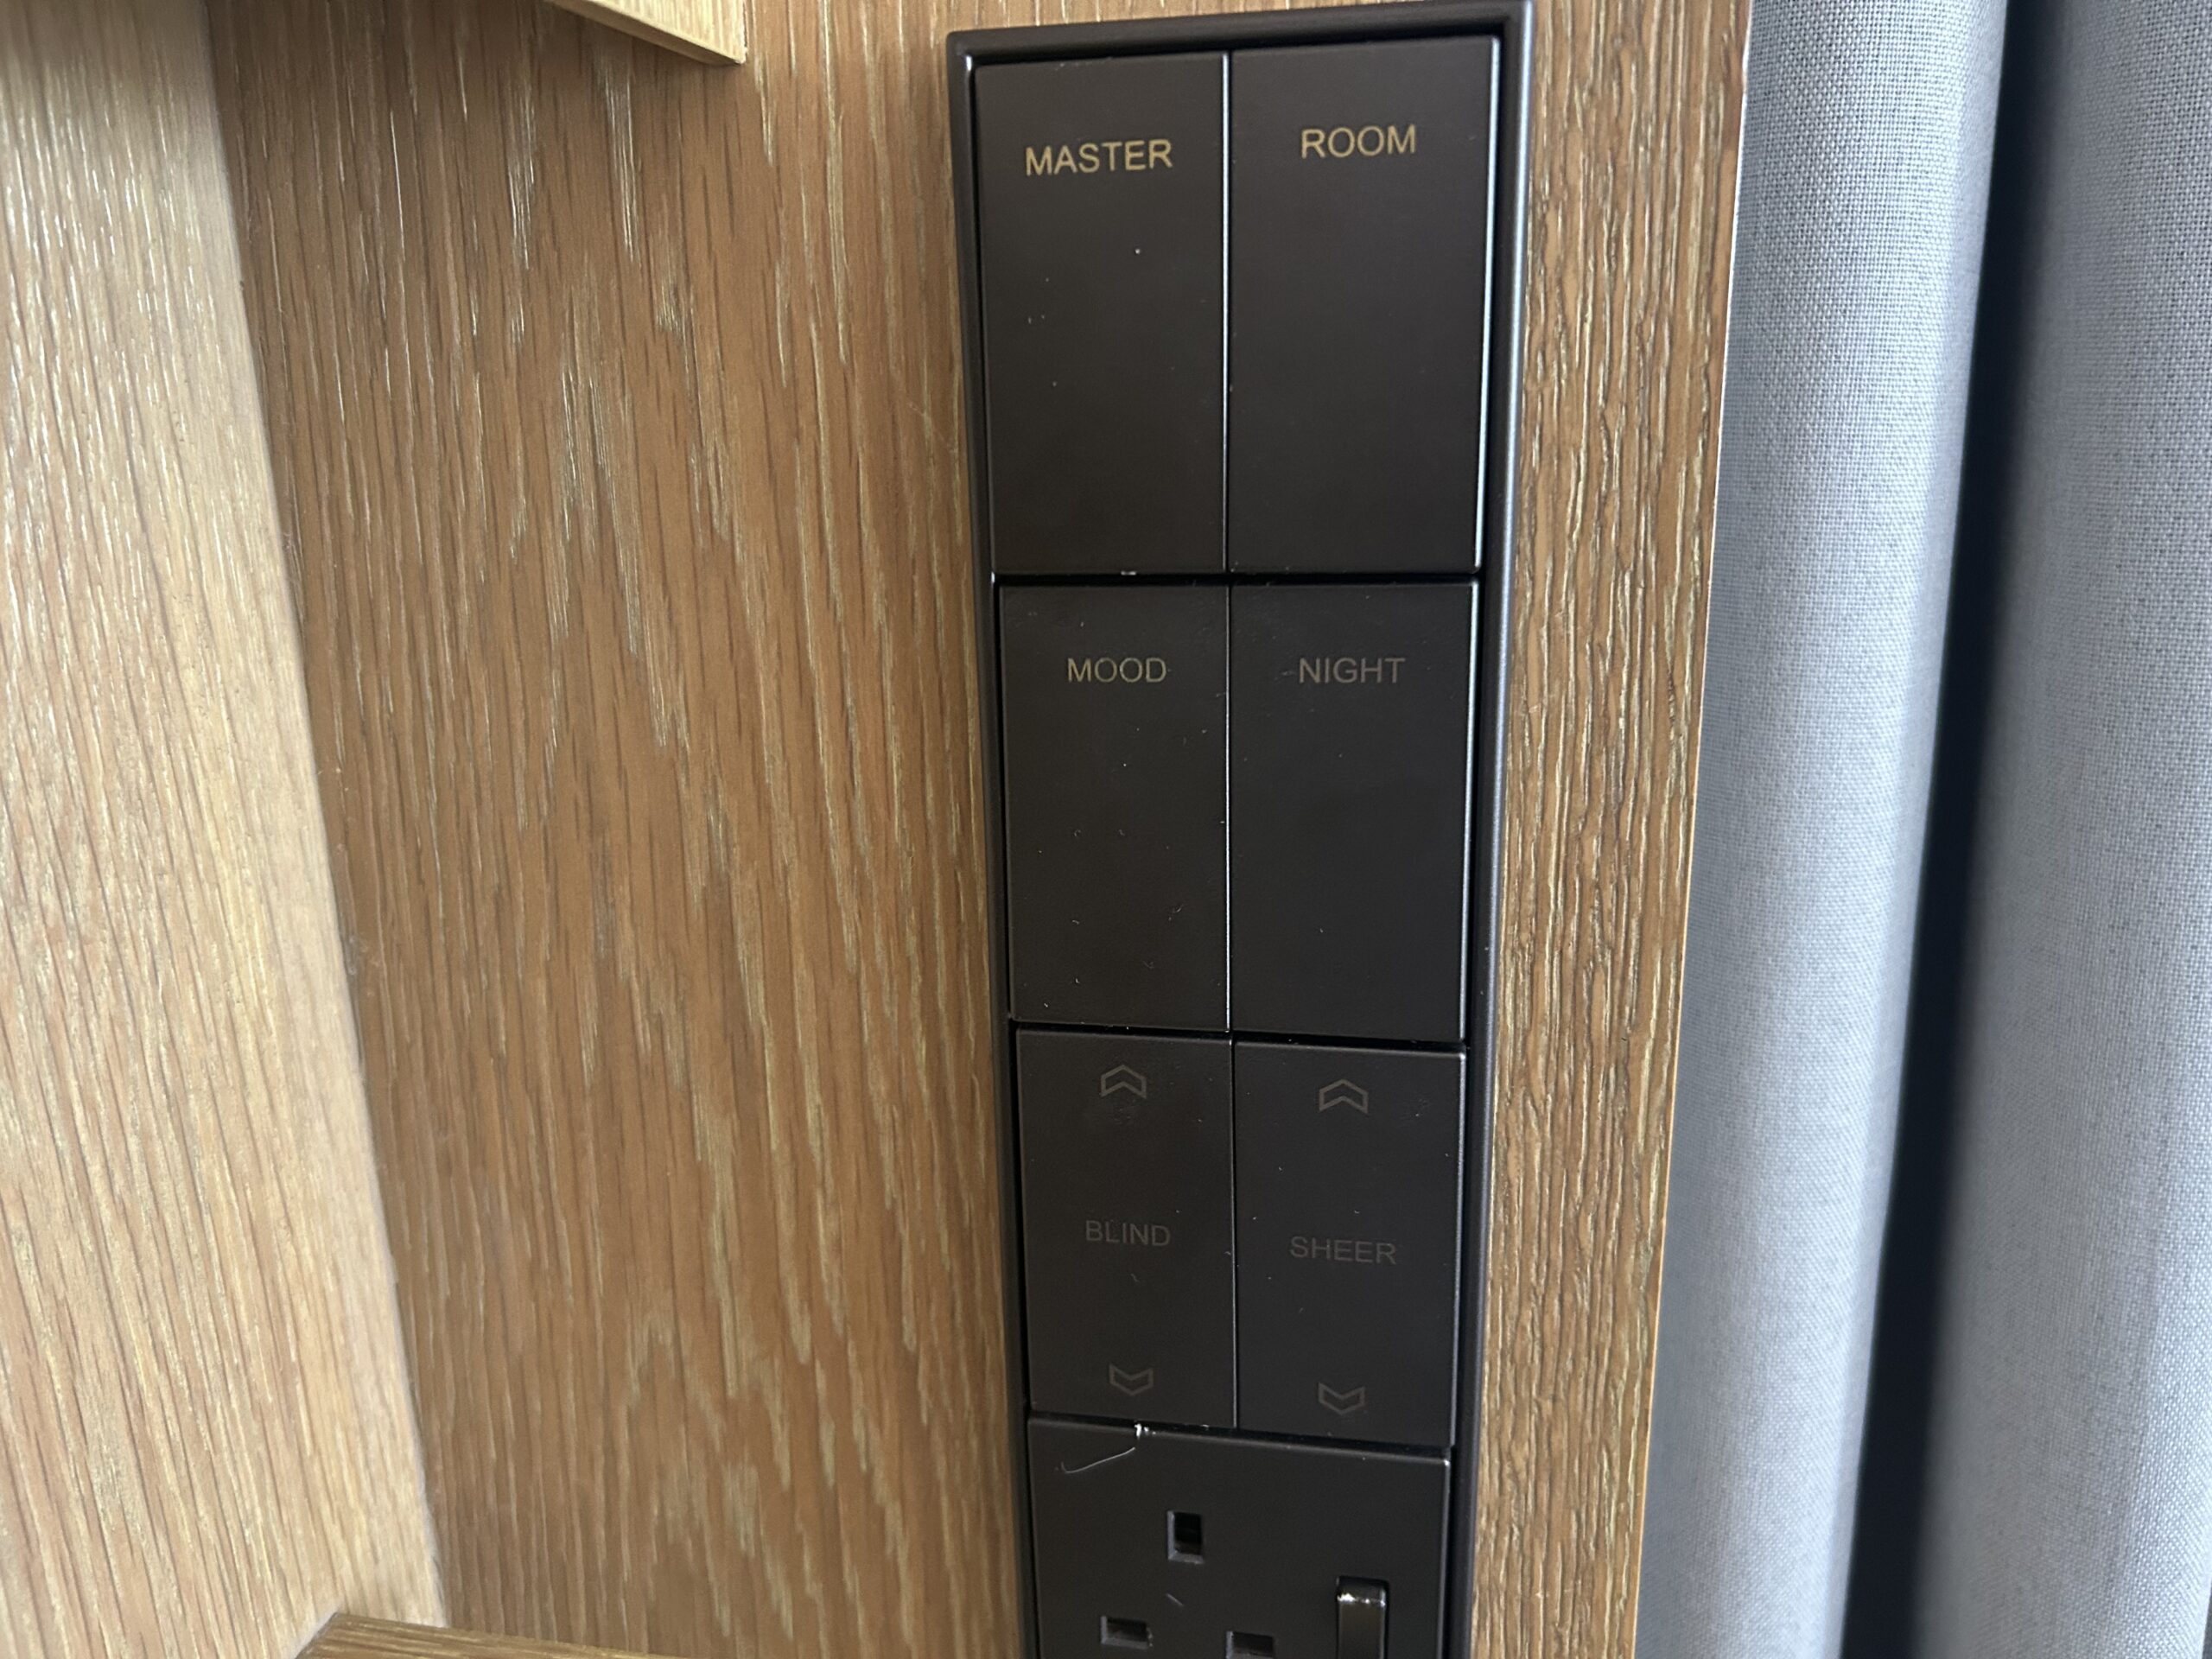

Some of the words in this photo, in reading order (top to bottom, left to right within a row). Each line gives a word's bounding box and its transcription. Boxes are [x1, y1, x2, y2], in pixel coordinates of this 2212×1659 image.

[1301, 124, 1416, 158] ROOM
[1026, 139, 1173, 176] MASTER
[1068, 658, 1167, 683] MOOD
[1299, 658, 1406, 683] NIGHT
[1085, 1221, 1171, 1248] BLIND
[1290, 1236, 1397, 1265] SHEER
